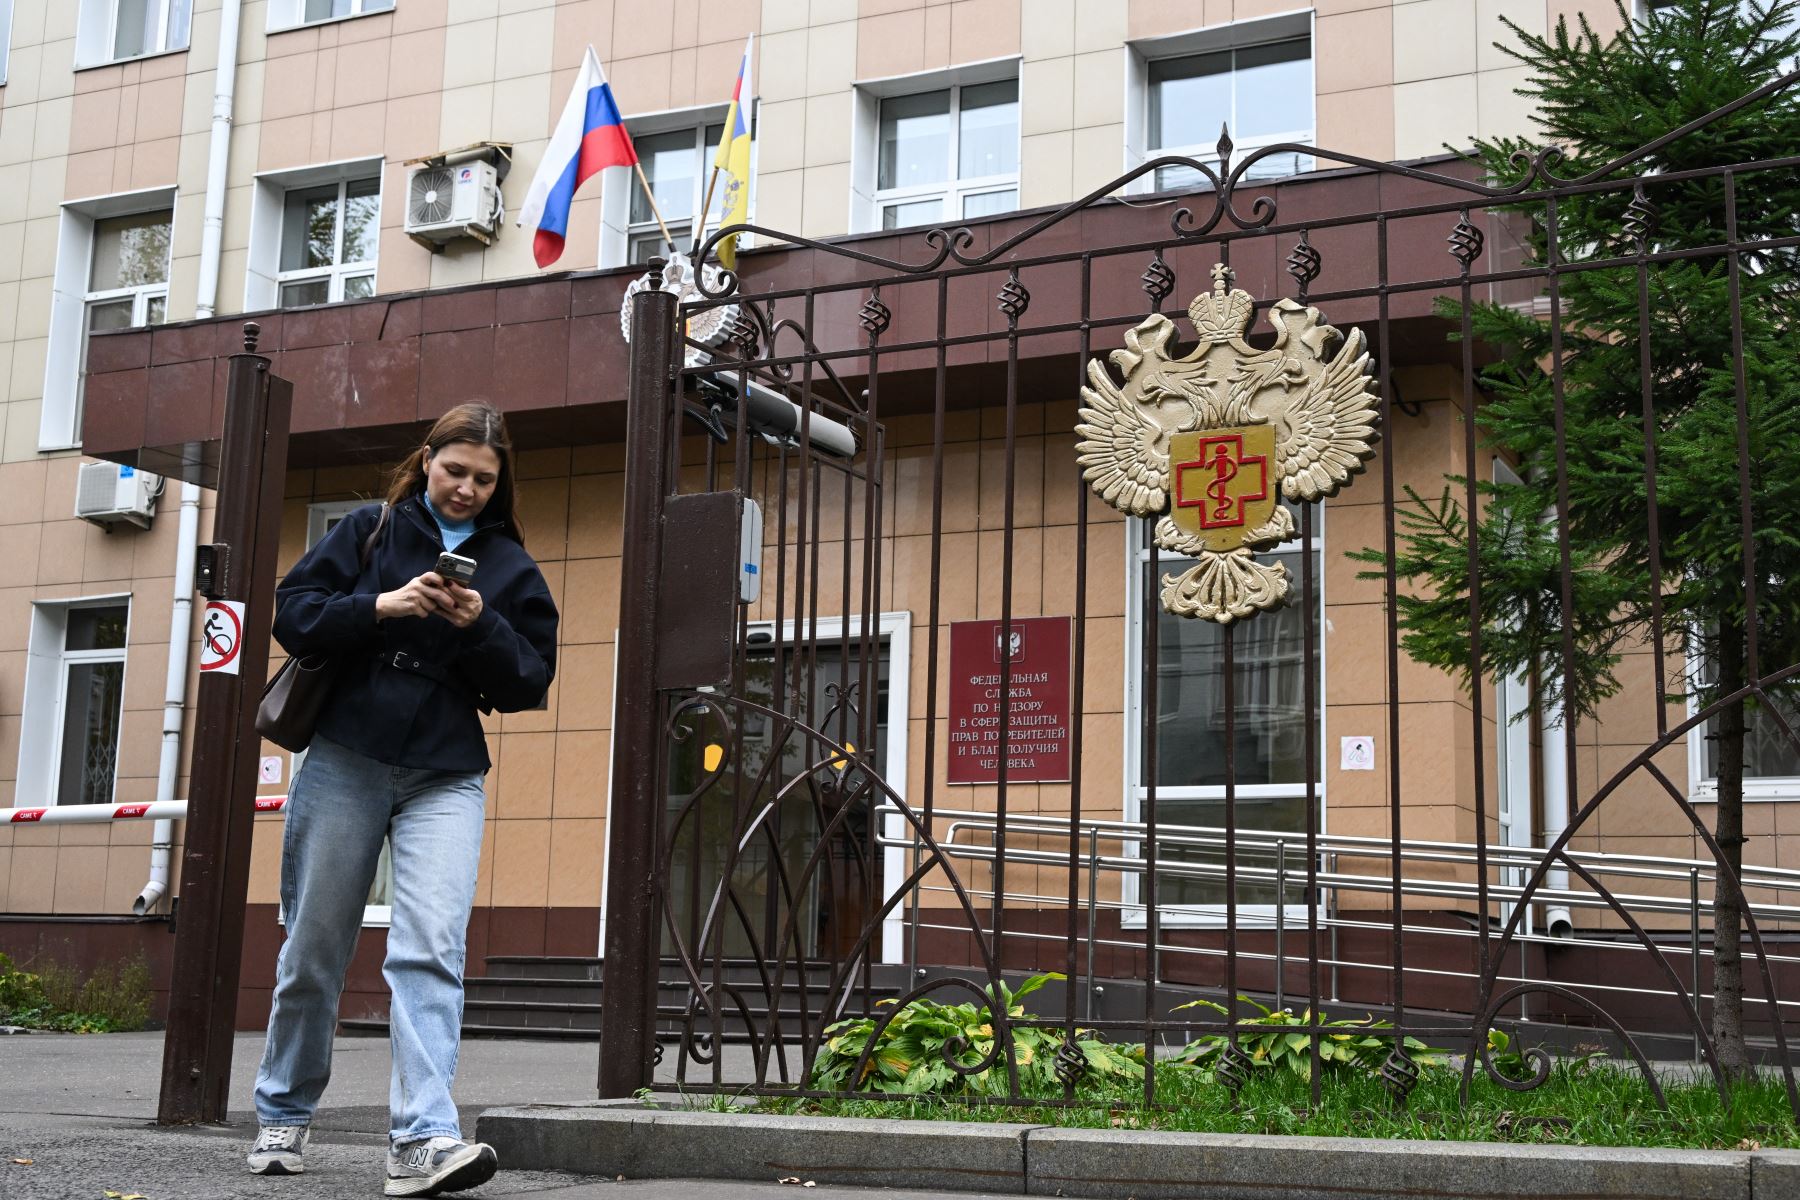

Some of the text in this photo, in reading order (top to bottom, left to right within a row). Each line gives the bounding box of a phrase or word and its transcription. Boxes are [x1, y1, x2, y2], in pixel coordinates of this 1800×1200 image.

[970, 673, 1048, 685] ФЕДЕЛЬНАЯ
[985, 688, 1032, 698] СЛЖБА
[973, 701, 1044, 713] ПО НДЗОРУ
[960, 715, 1057, 728] В СФЕР ЗАЩИТЫ
[952, 728, 1065, 742] ПРАВ ПОЕБИТЕЛЕЙ
[958, 743, 1058, 756] И БЛАГПОЛУЧИЯ
[981, 759, 1035, 769] ЧЕЛВЕКА
[409, 1146, 429, 1168] N
